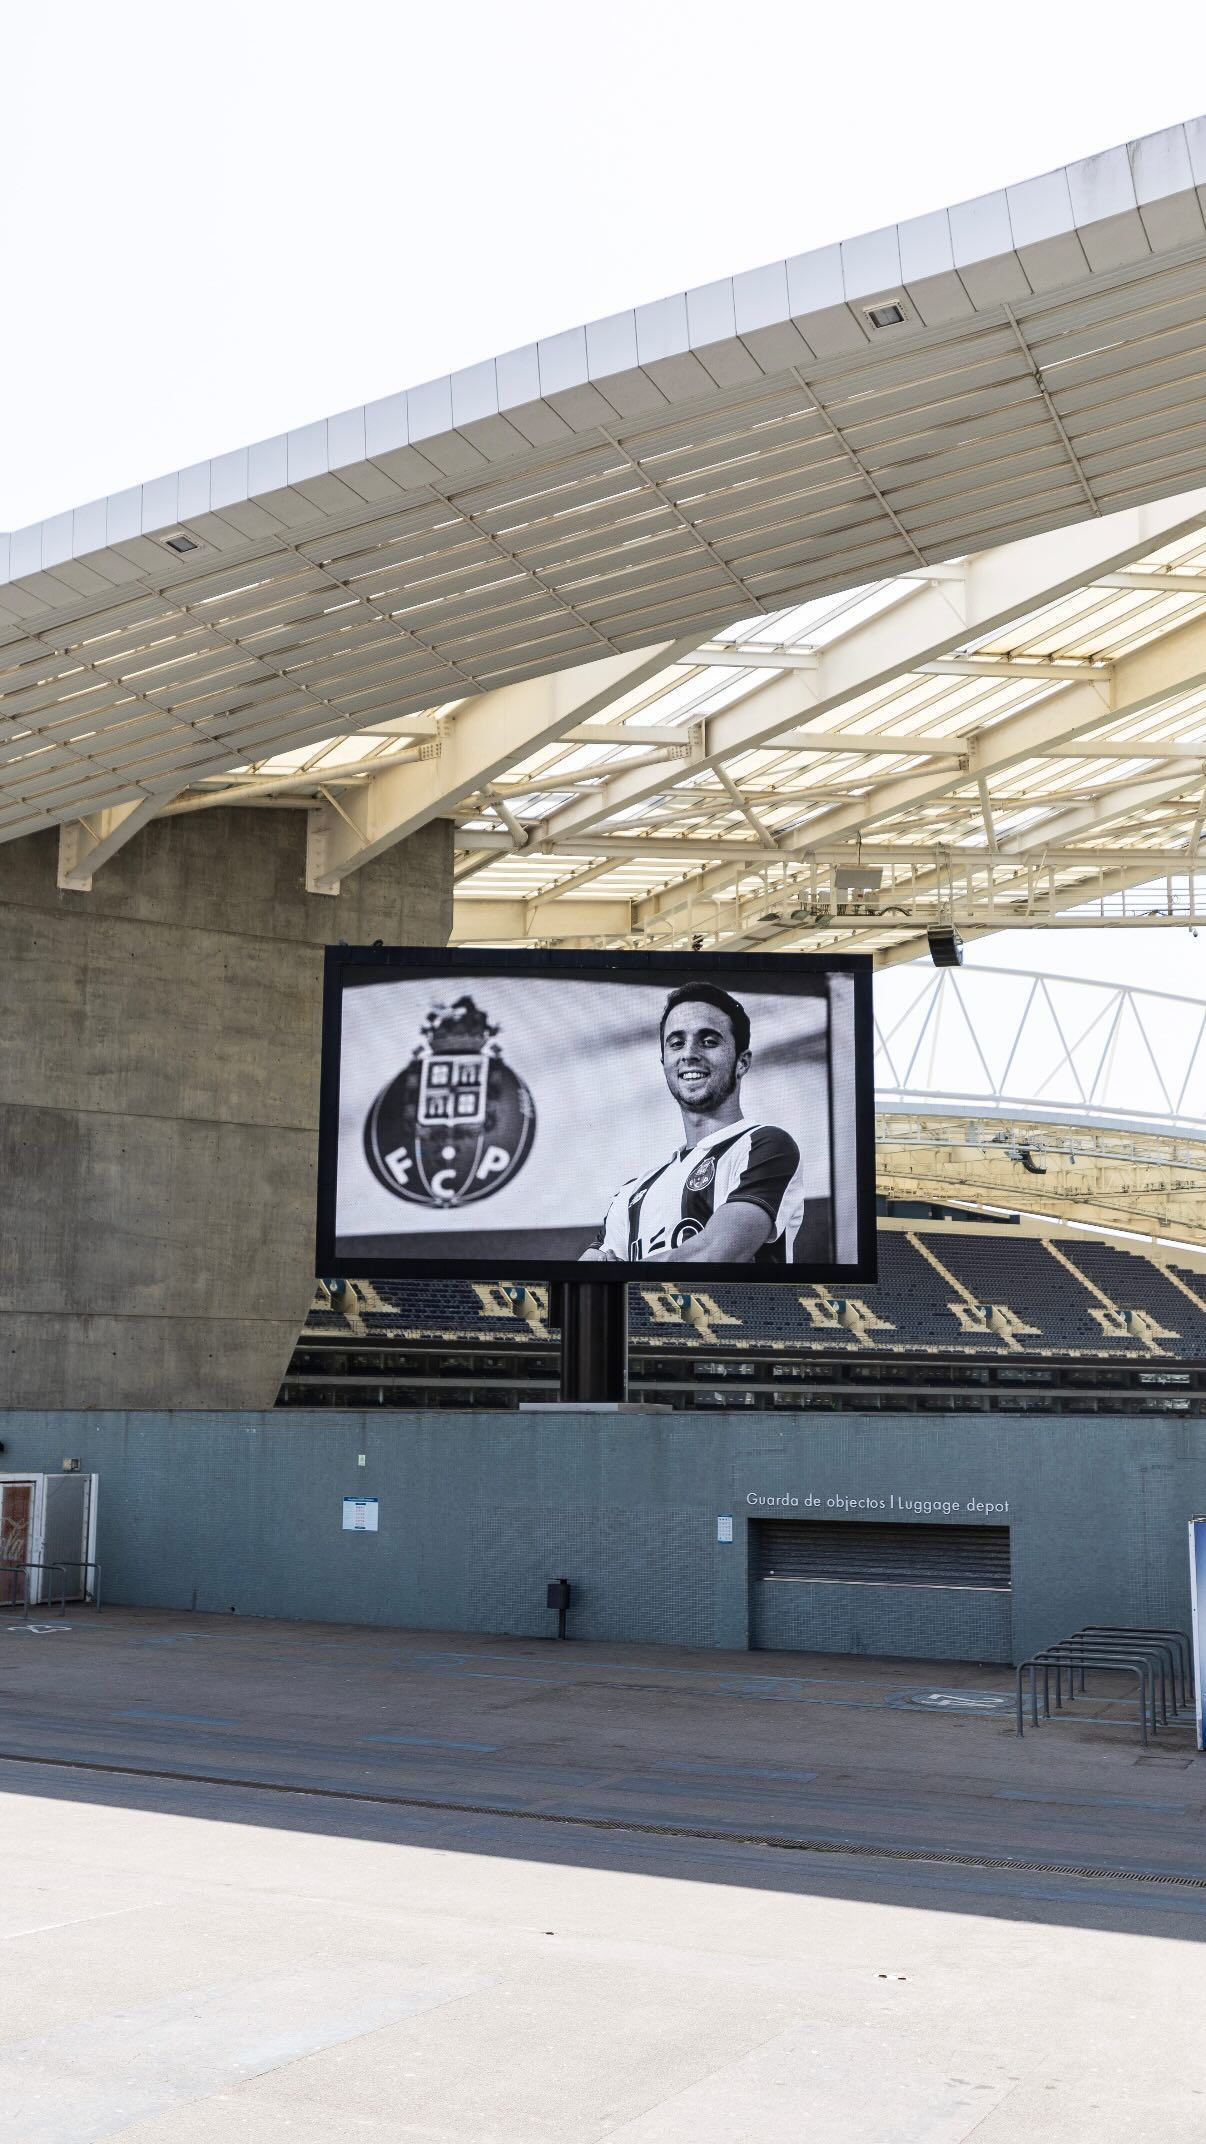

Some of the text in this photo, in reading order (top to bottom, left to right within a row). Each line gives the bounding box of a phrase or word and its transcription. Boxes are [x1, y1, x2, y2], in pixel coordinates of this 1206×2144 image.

[746, 1492, 799, 1506] Guarda
[804, 1492, 821, 1507] de
[826, 1493, 886, 1511] objectos
[898, 1496, 960, 1515] Luggage
[966, 1497, 1010, 1516] depot
